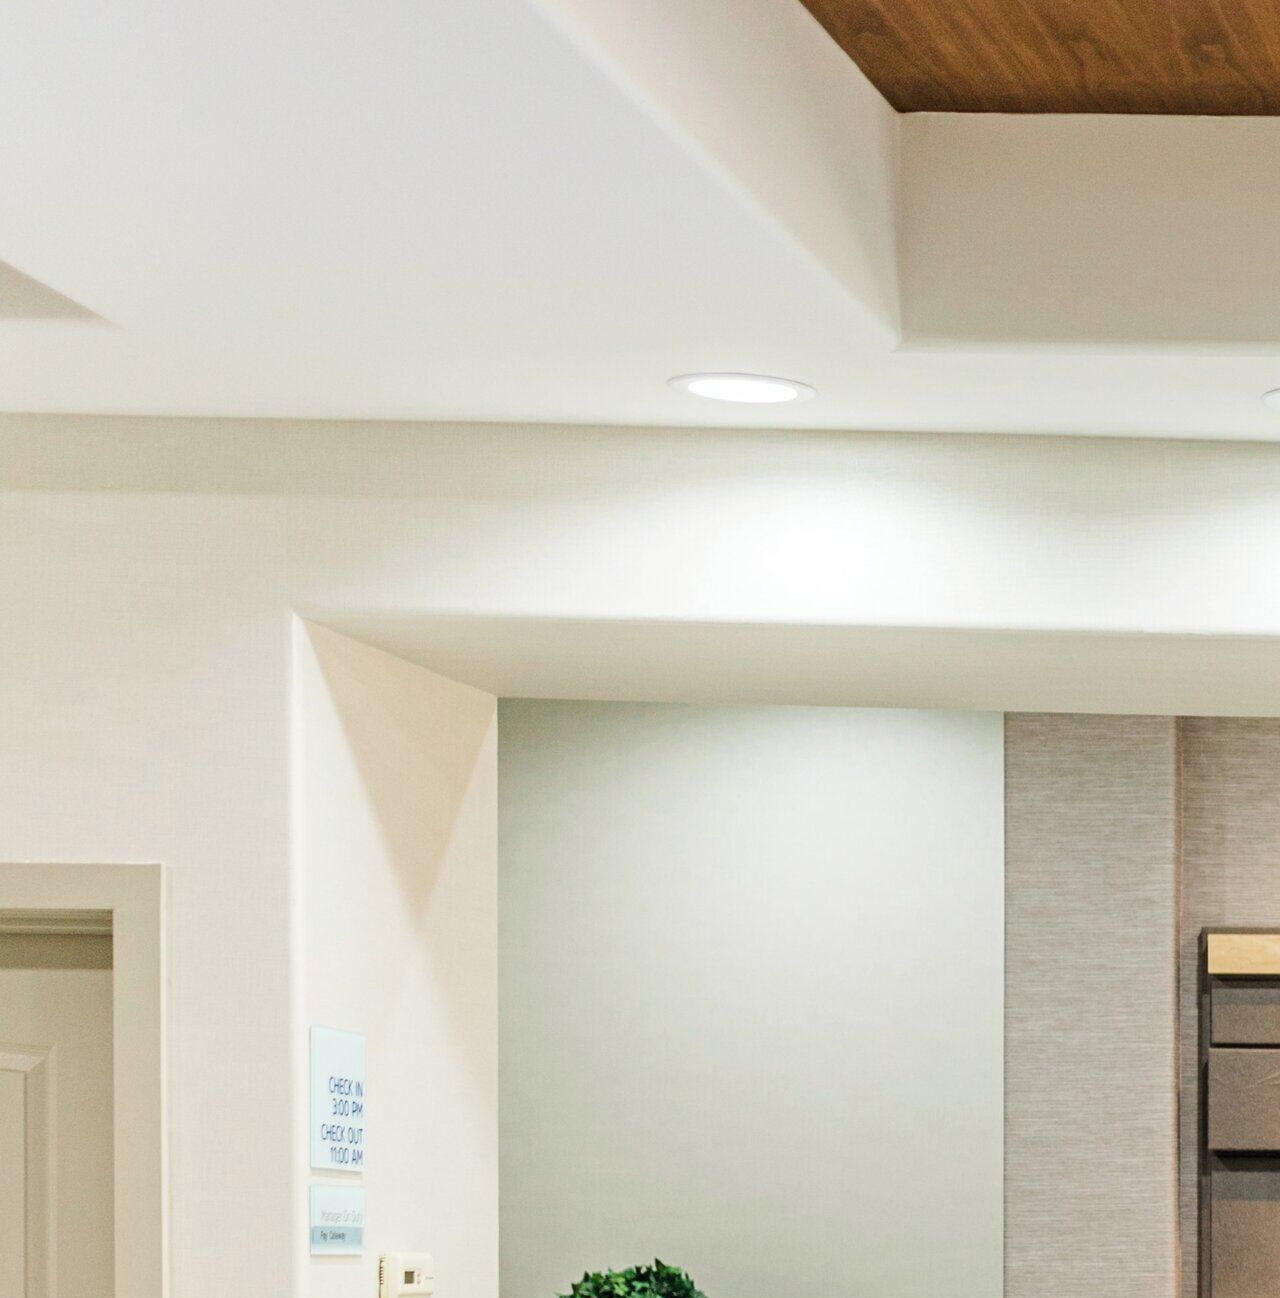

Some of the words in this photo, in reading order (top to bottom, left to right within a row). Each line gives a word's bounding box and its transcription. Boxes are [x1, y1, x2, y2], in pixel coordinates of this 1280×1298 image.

[329, 1076, 353, 1096] CHECK
[355, 1080, 363, 1097] IN
[332, 1098, 350, 1117] 3:00
[351, 1101, 363, 1118] PM
[321, 1123, 346, 1142] CHECK
[348, 1127, 363, 1144] OUT
[351, 1148, 363, 1165] AM
